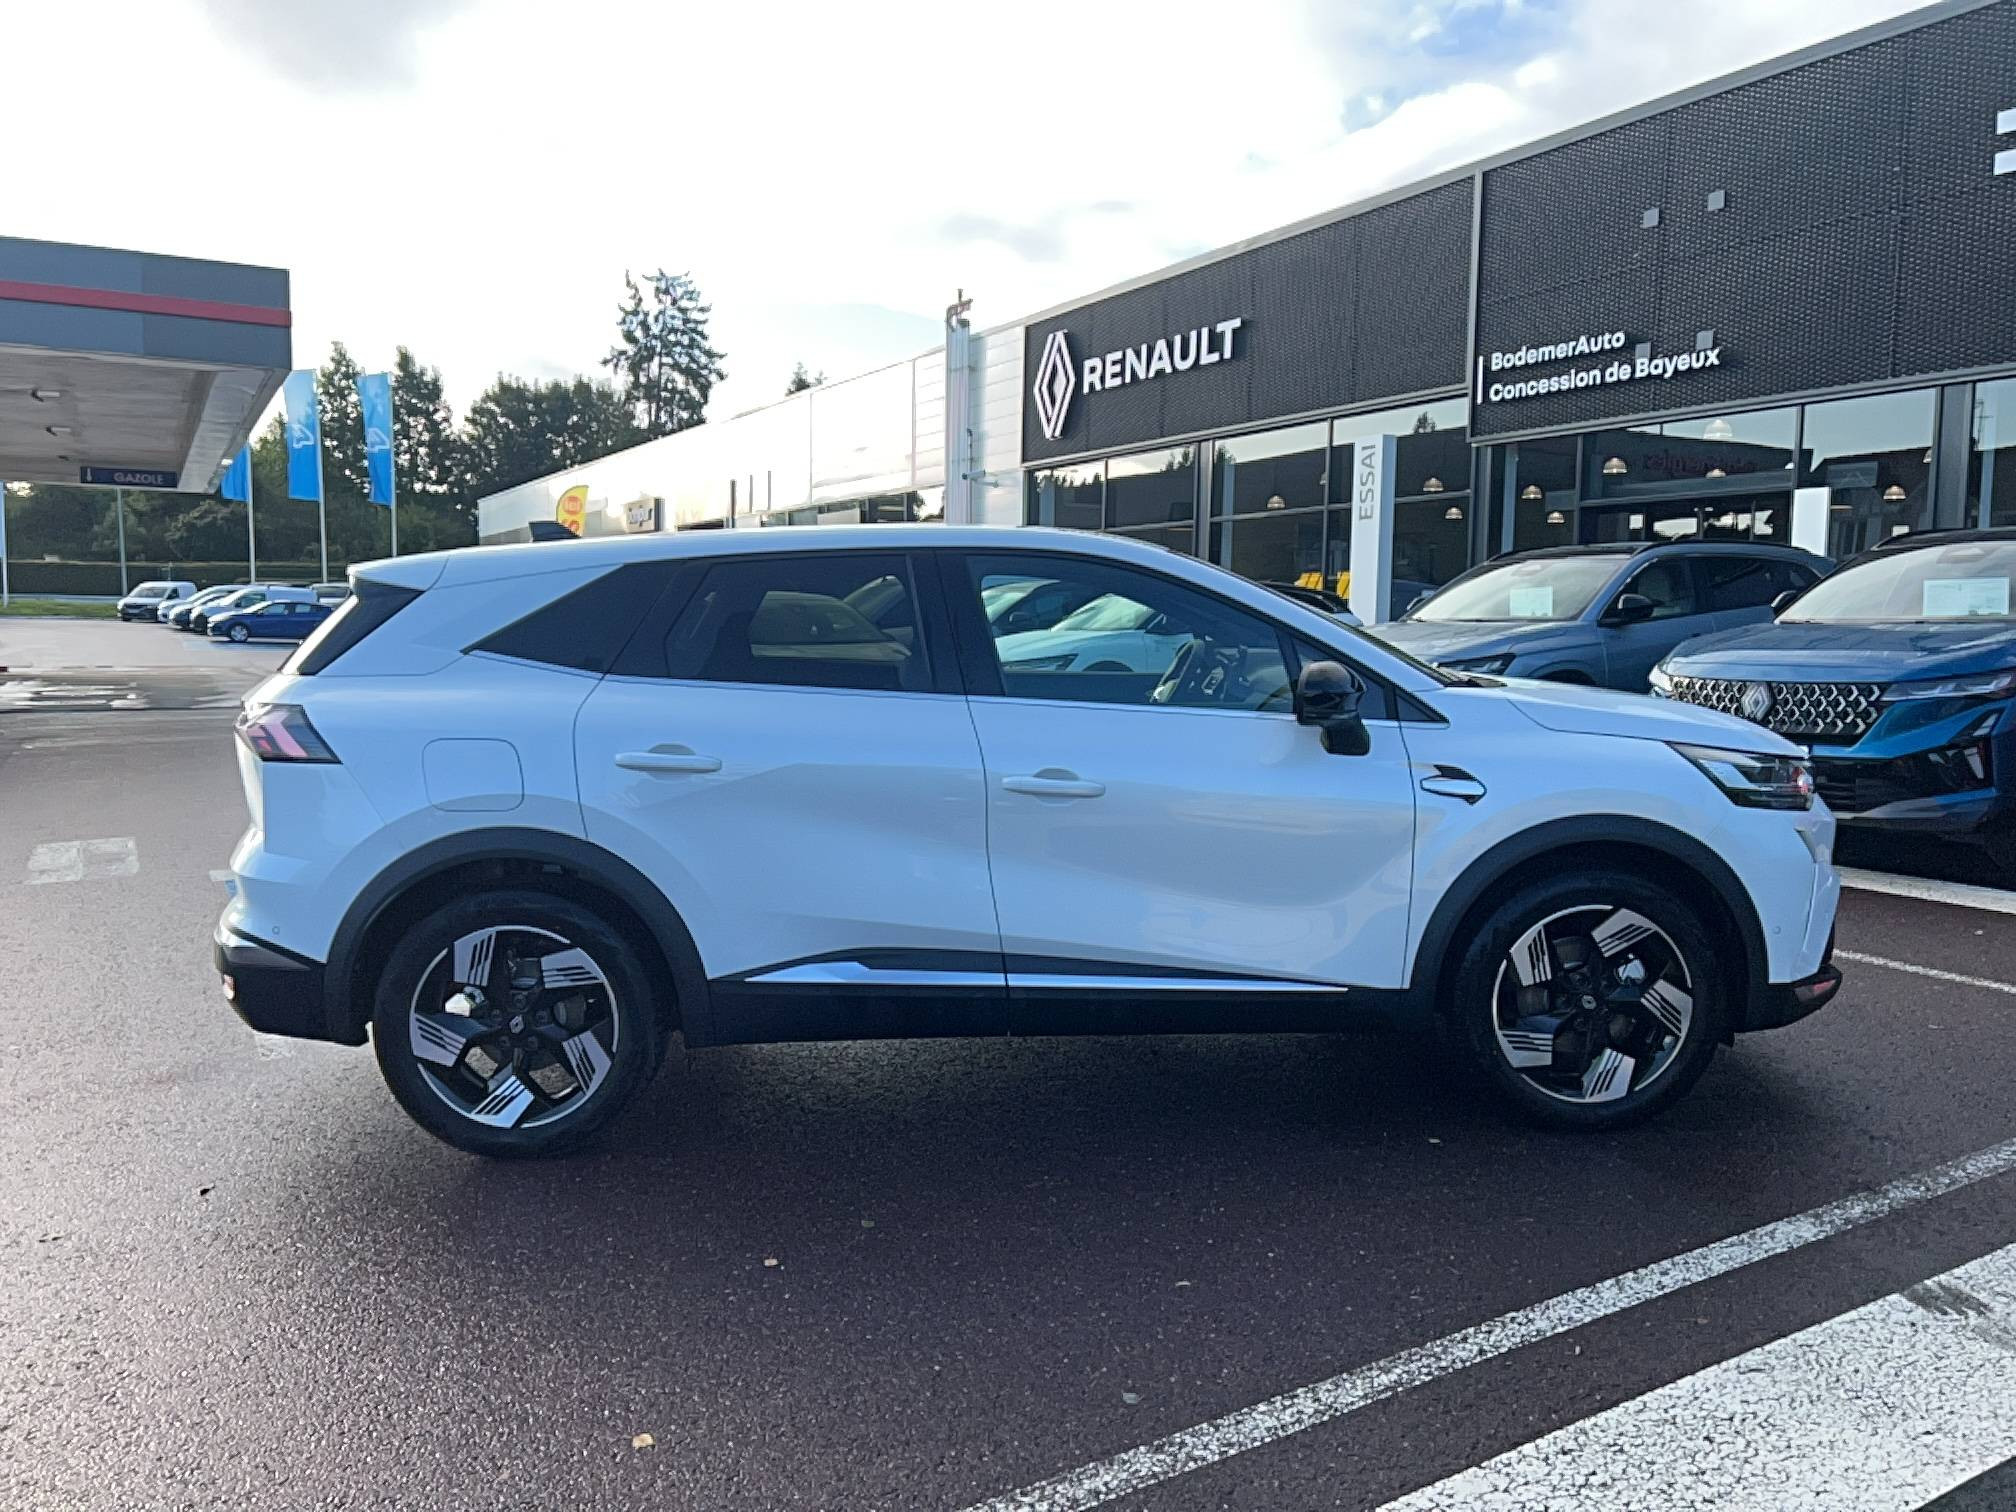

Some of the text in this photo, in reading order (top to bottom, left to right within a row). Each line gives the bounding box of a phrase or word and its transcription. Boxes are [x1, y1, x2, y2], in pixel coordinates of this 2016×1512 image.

[1082, 317, 1242, 395] RENAULT
[1489, 347, 1721, 402] Concession de Bayeux
[1490, 330, 1626, 372] BodemerAuto
[113, 471, 164, 485] GAZOLE
[1359, 444, 1376, 520] ESSAI
